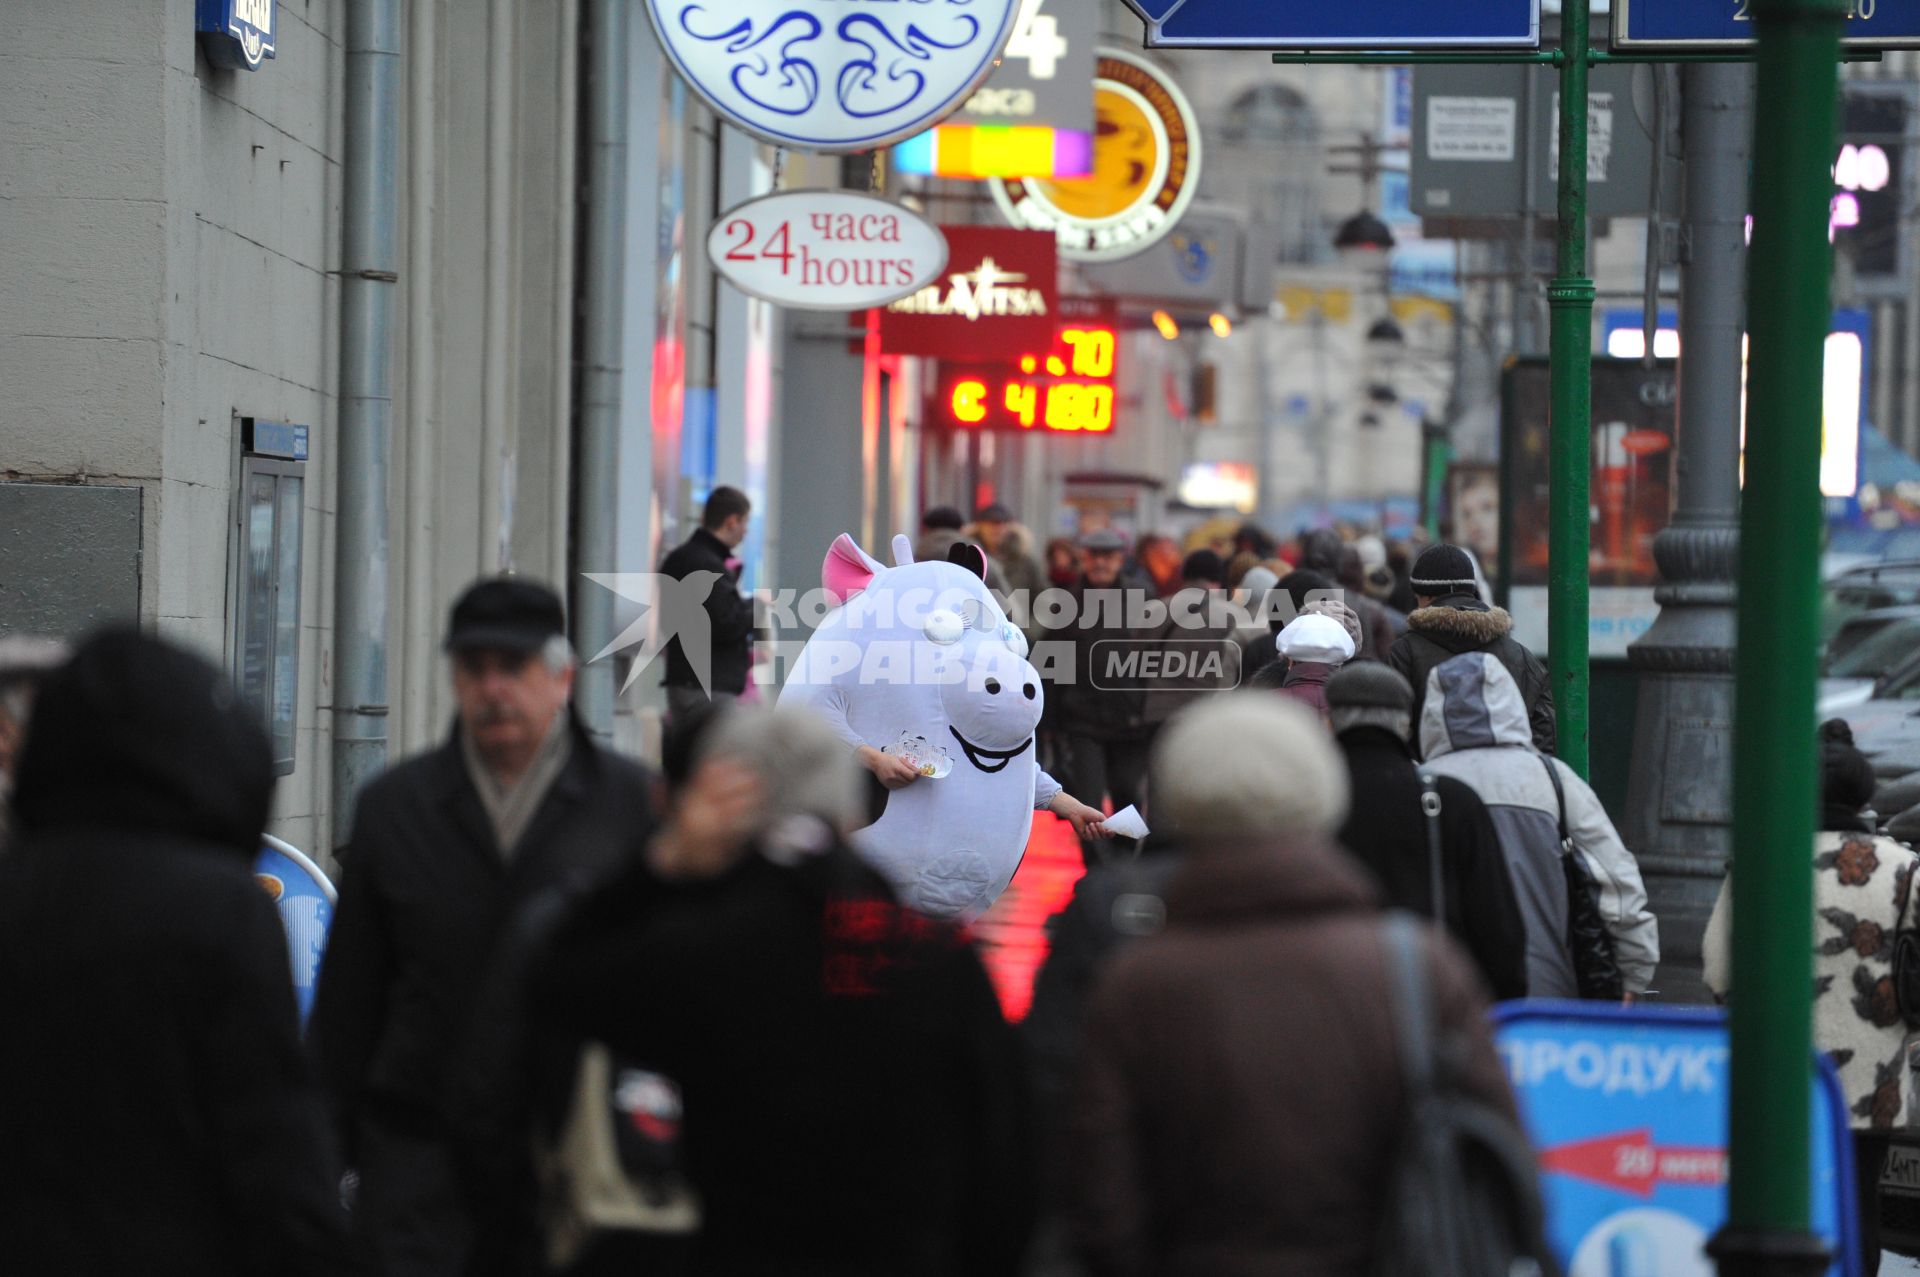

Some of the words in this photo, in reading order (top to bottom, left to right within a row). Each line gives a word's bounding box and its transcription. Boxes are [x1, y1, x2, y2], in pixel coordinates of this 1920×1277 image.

[724, 219, 795, 275] 24
[809, 213, 901, 241] часа
[799, 245, 914, 286] hours
